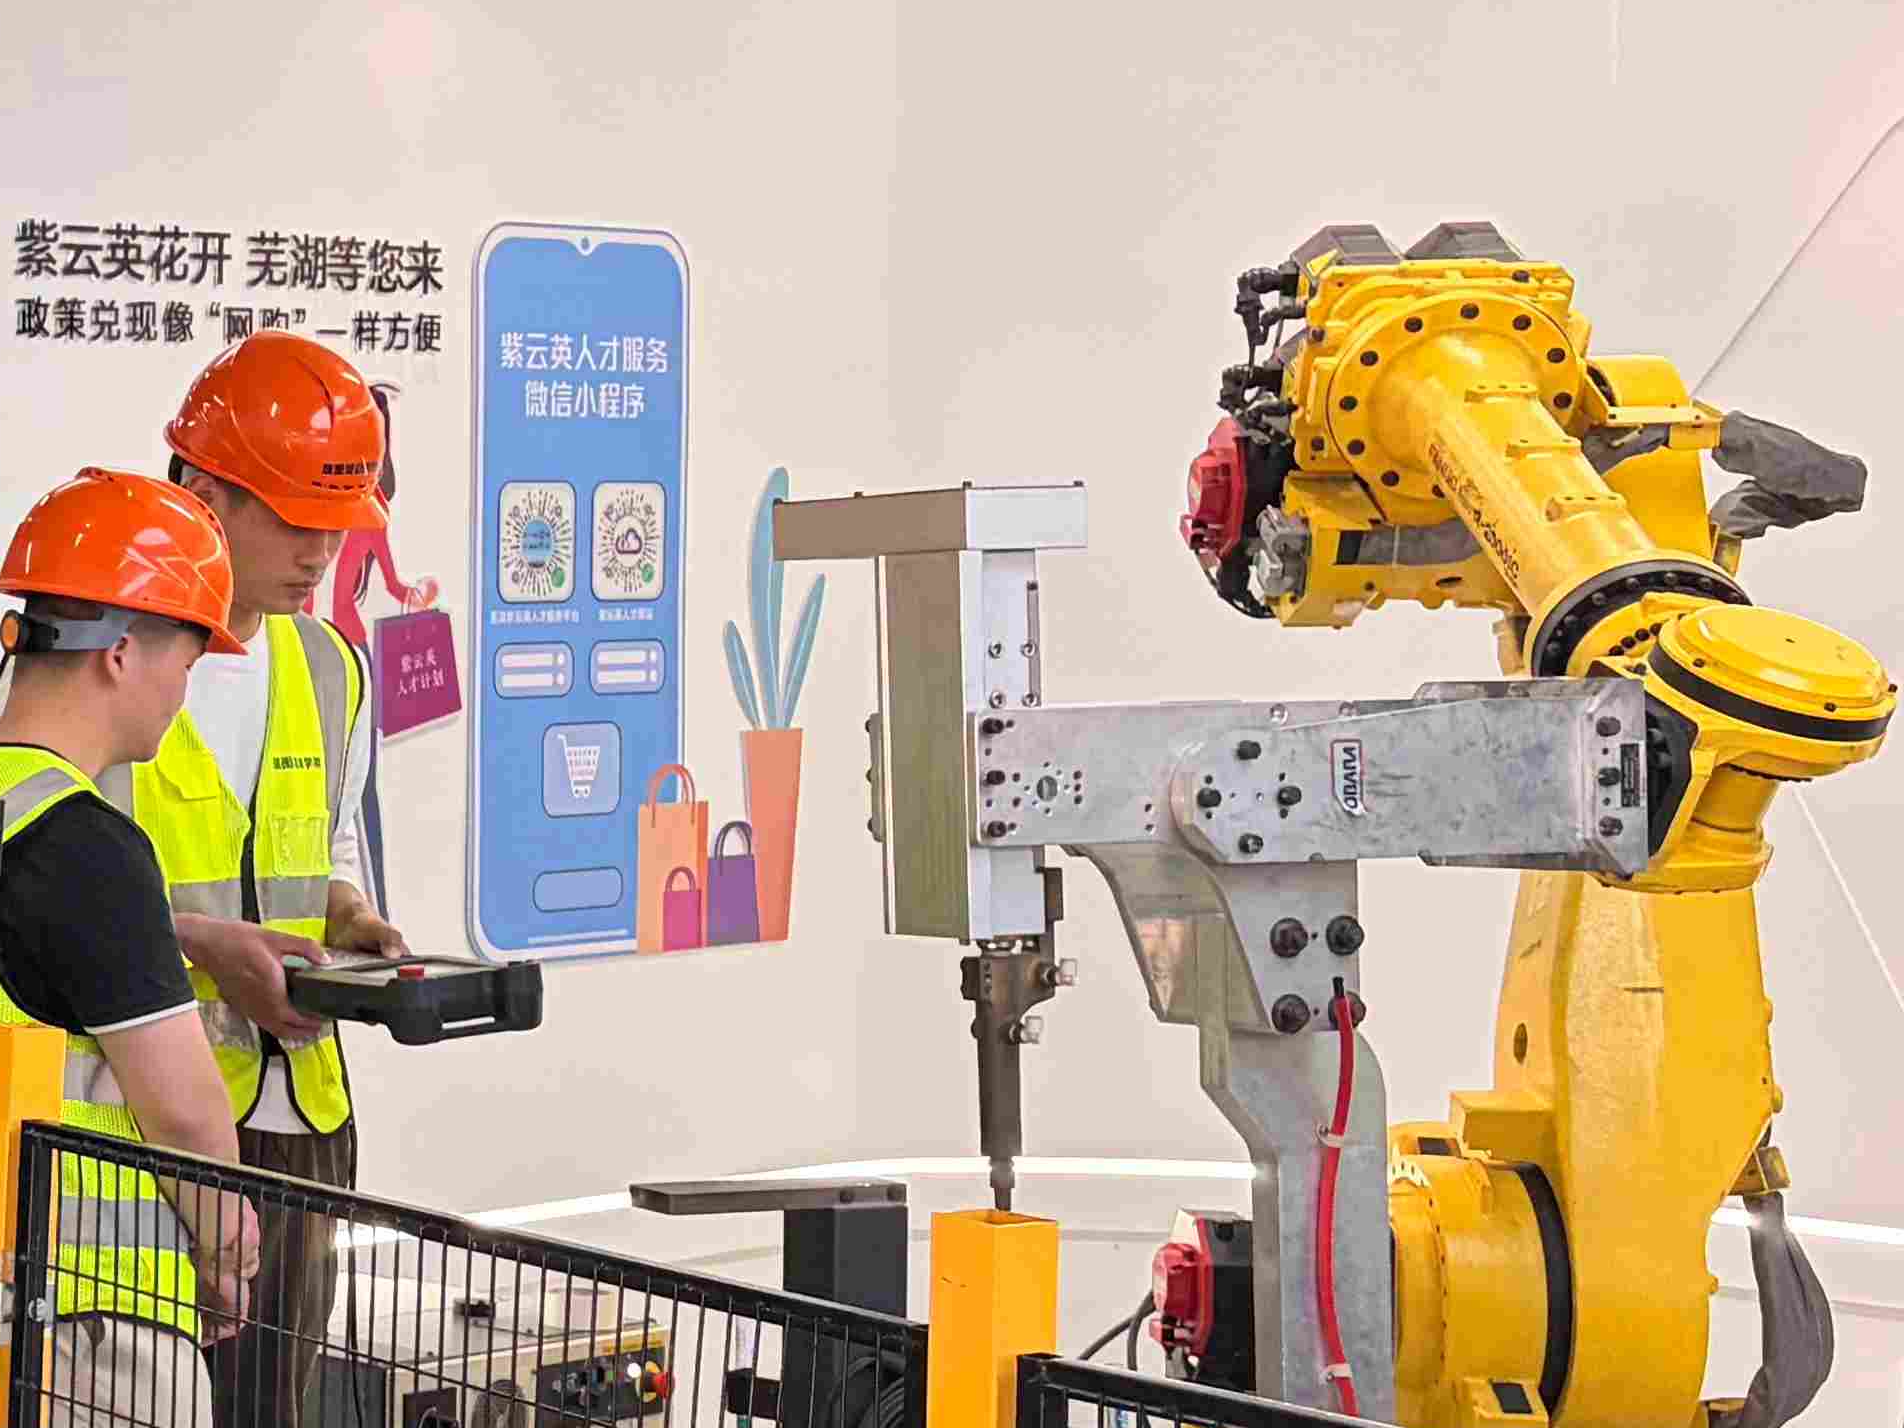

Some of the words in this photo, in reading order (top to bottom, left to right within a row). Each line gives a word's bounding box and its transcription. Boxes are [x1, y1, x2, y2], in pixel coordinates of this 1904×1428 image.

[14, 217, 232, 286] 紫云英花开
[246, 230, 444, 295] 芜湖等您来
[499, 331, 669, 374] 紫云英人才服务
[524, 379, 647, 420] 微信小程序
